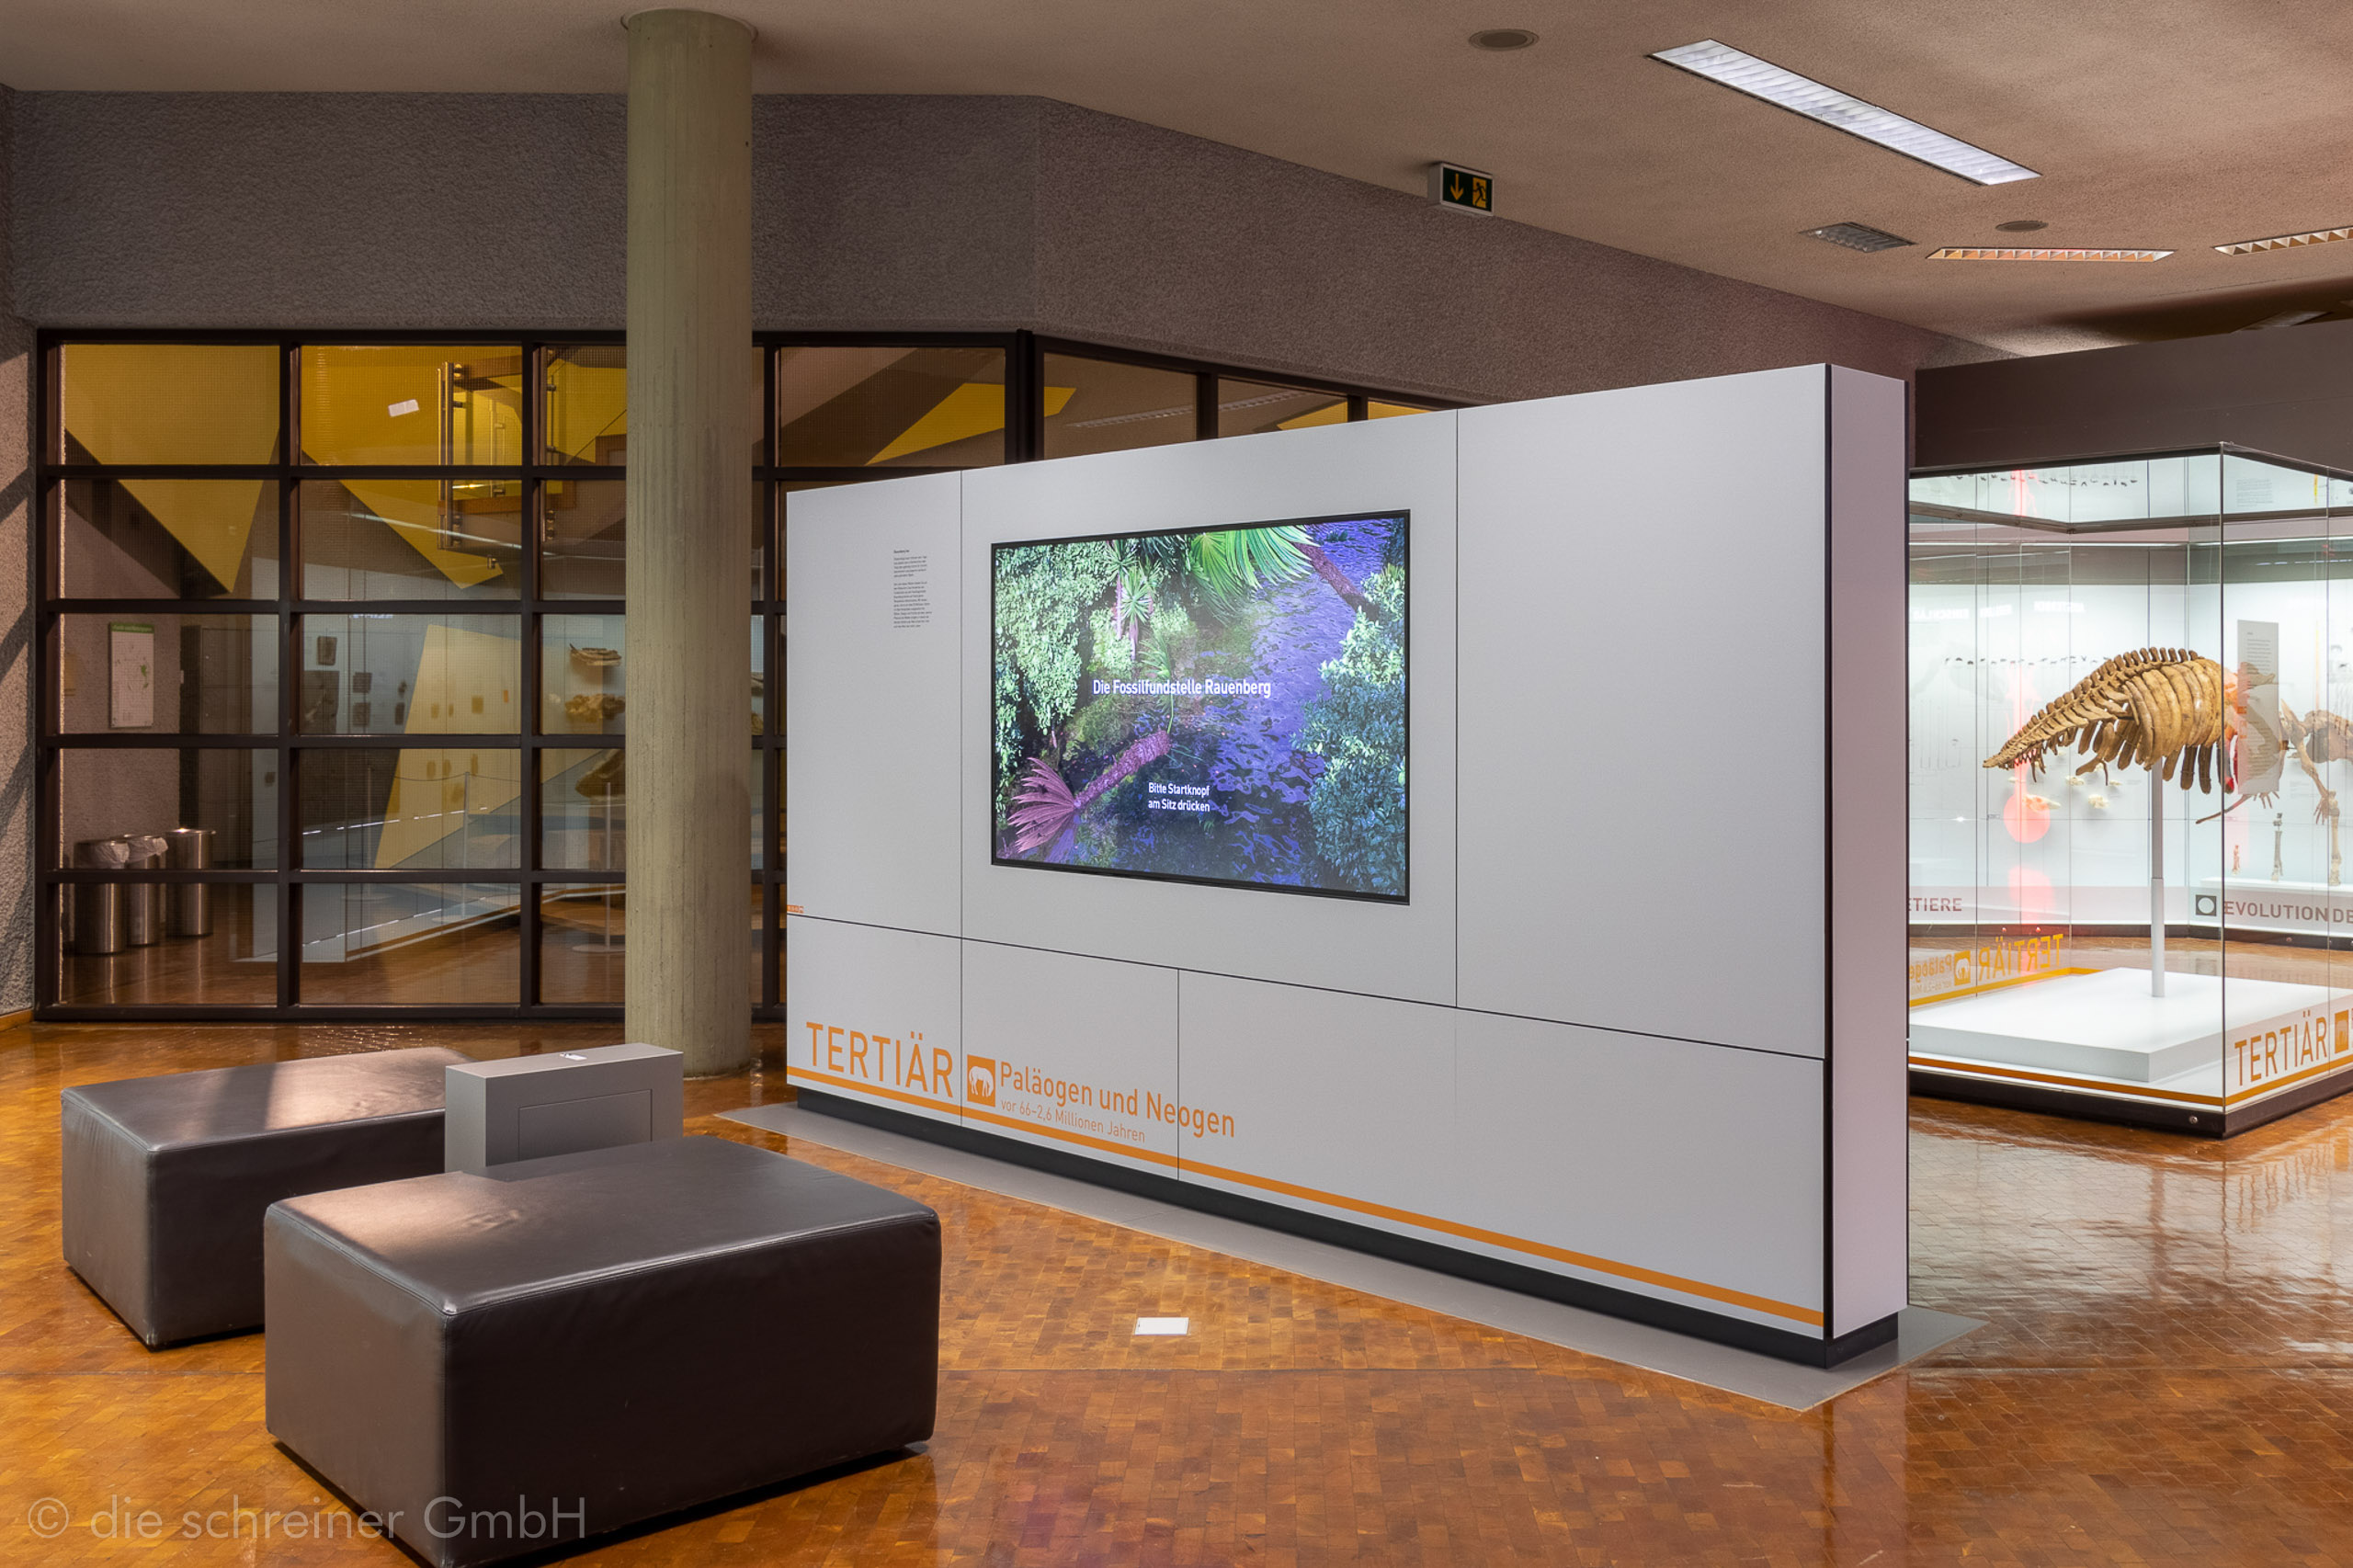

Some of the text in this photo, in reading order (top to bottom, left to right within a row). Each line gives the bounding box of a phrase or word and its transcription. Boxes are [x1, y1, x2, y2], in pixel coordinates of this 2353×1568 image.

[1093, 678, 1271, 698] Die Fossilfundstelle Rauenberg
[1148, 782, 1210, 798] Bitte Startknopf
[1148, 799, 1211, 812] am Sitz drücken
[2224, 901, 2329, 922] EVOLUTION
[806, 1021, 953, 1097] TERTIÄR
[2234, 1009, 2327, 1086] TERTIÄR
[1000, 1062, 1235, 1138] Paläogen und Neogen
[1001, 1099, 1016, 1112] vor
[1055, 1108, 1104, 1132] Millionen
[1107, 1120, 1145, 1142] Jahren
